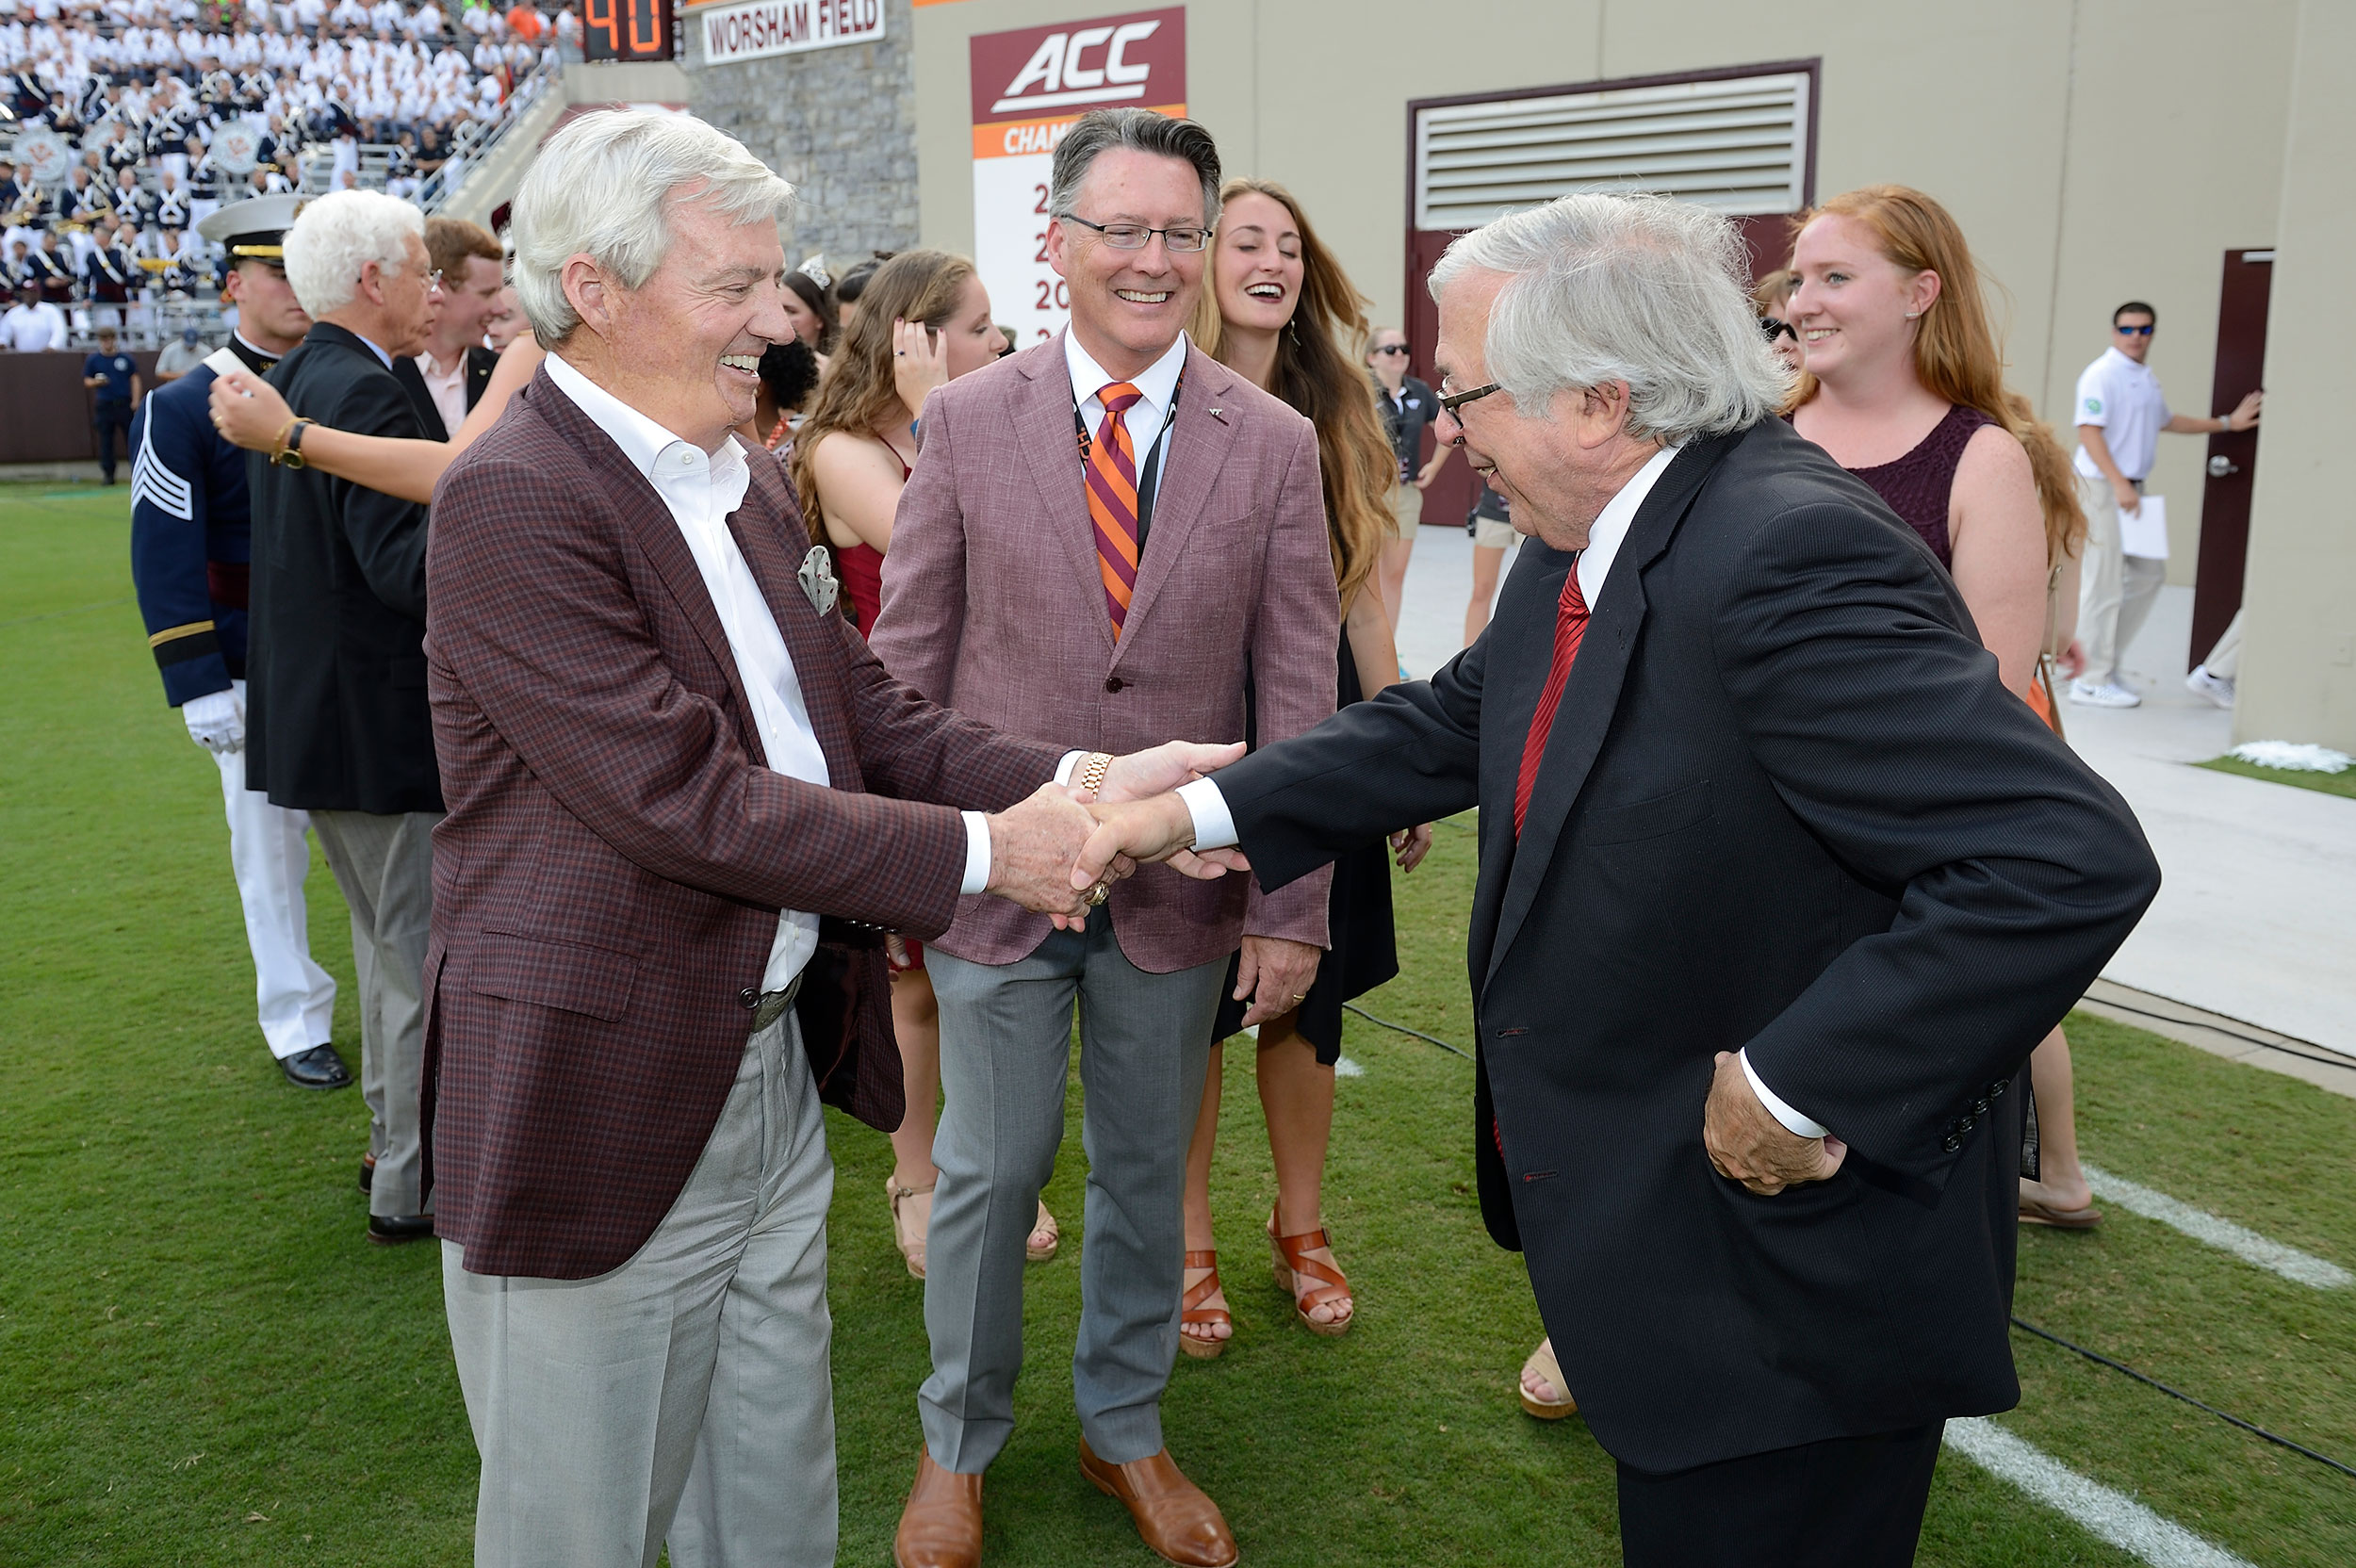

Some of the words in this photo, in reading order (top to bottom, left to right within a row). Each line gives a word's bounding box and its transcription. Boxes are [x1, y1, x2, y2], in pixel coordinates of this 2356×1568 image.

[585, 0, 662, 53] 40
[709, 2, 810, 56] WORSHAM
[818, 0, 877, 39] FIELD
[1004, 19, 1162, 97] ACC
[1003, 122, 1076, 155] CHAM
